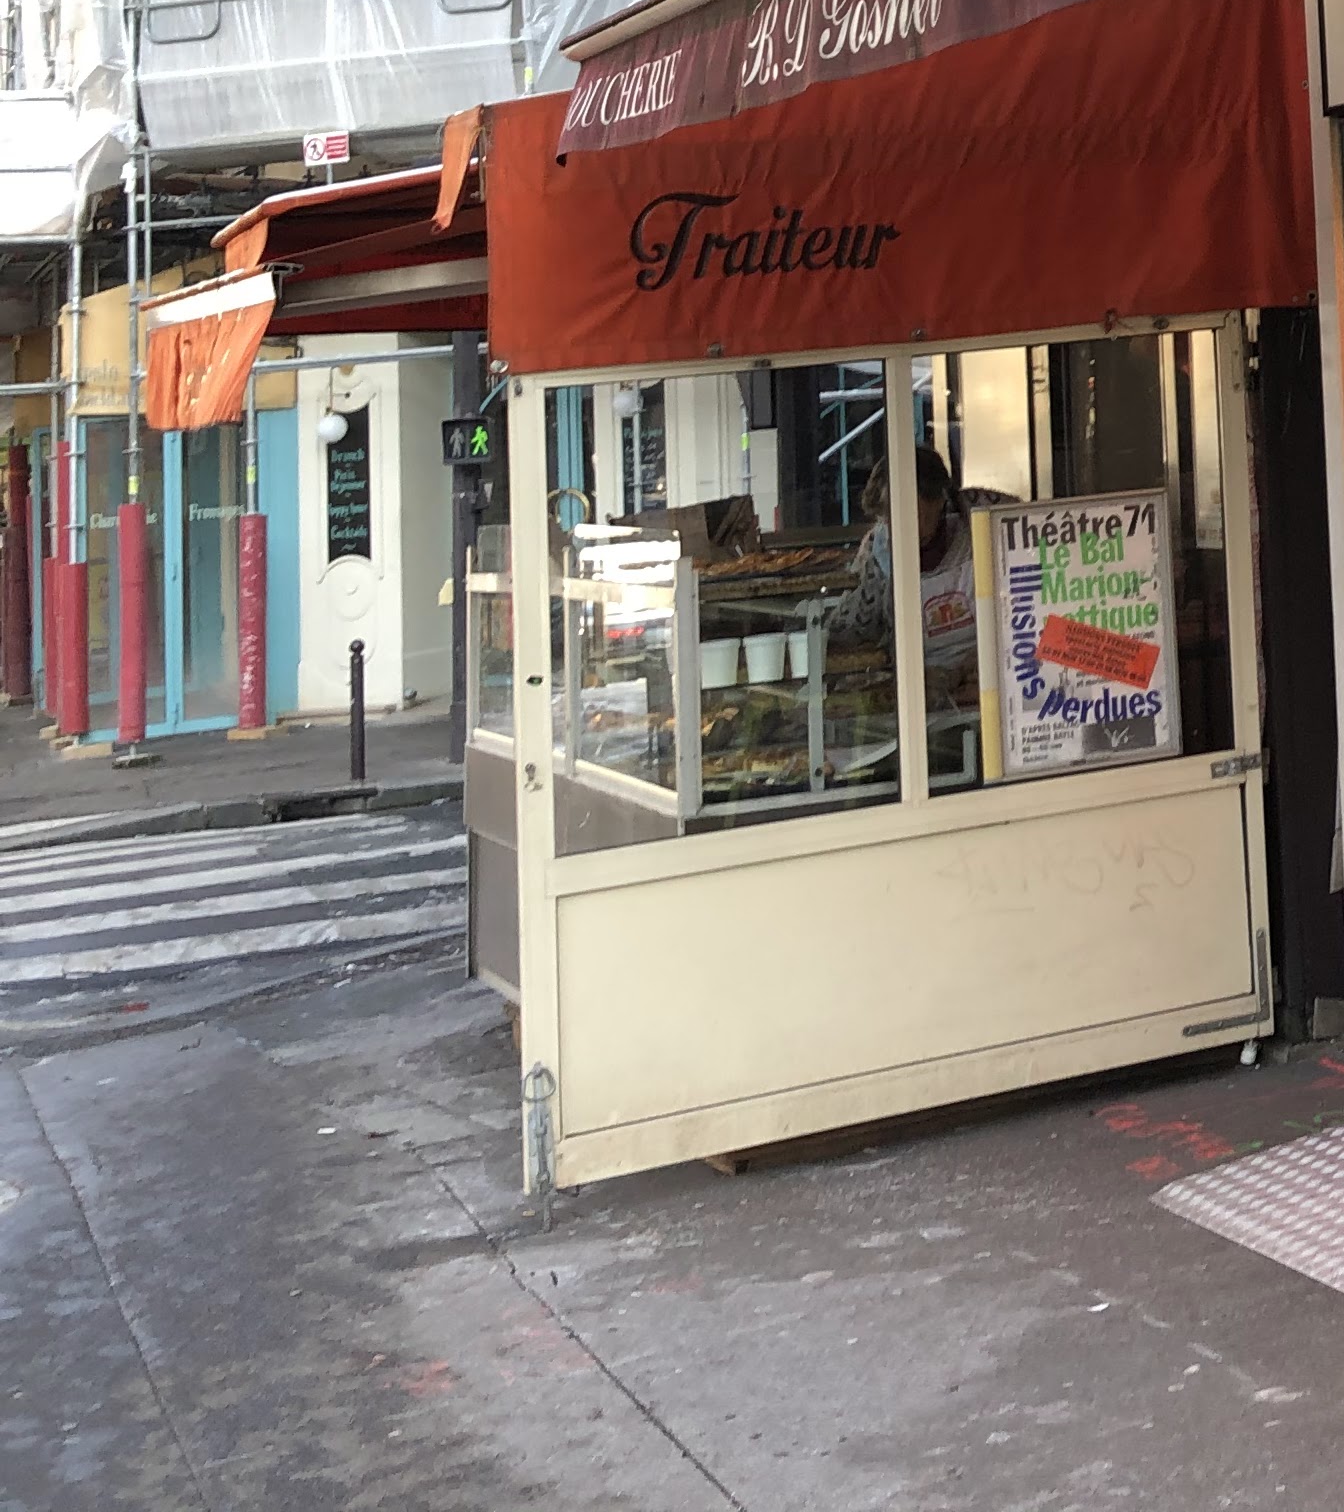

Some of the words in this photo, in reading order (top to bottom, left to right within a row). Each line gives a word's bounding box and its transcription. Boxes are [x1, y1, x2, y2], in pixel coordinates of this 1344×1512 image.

[563, 49, 683, 132] OUCHERIE
[629, 191, 901, 292] Traiteur
[1038, 537, 1071, 570] Le
[1080, 528, 1124, 566] Bal
